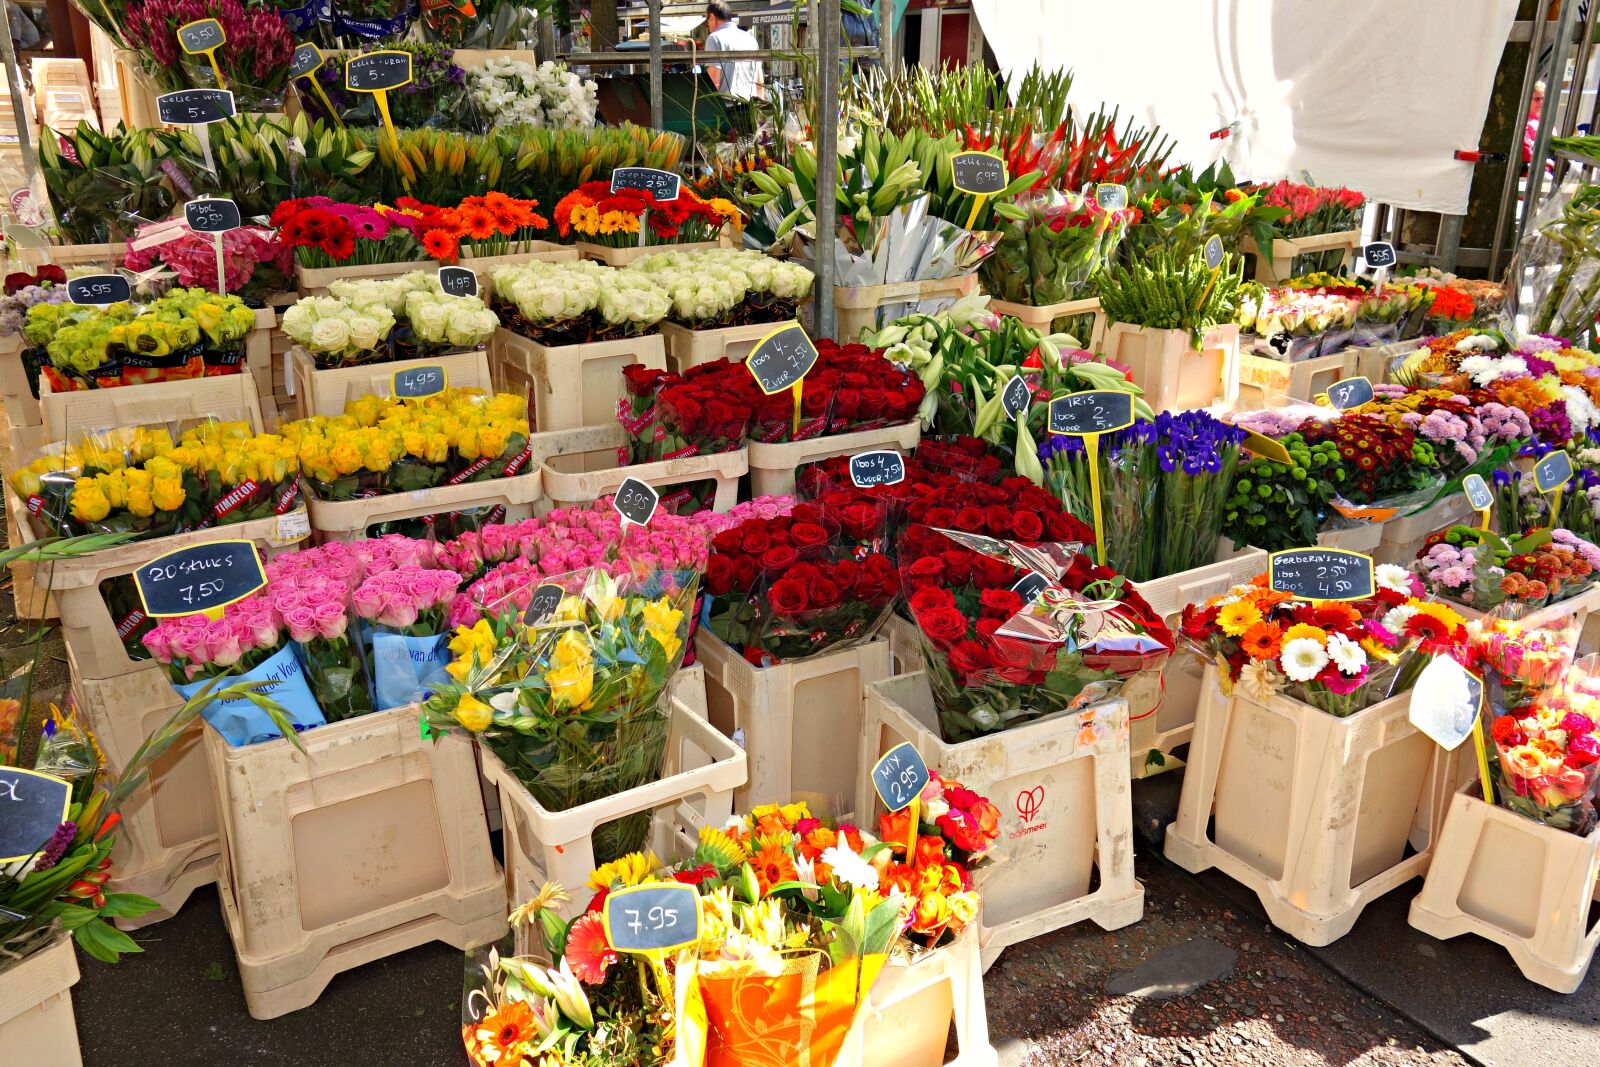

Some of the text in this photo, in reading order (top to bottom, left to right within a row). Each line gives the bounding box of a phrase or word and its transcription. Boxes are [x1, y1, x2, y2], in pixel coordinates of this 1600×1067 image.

[77, 283, 112, 298] 3.95
[447, 275, 471, 290] 4.95
[214, 480, 257, 514] TIMAFLOR
[179, 578, 225, 604] 7.50
[890, 765, 919, 804] 2.95
[624, 905, 680, 935] 7.95
